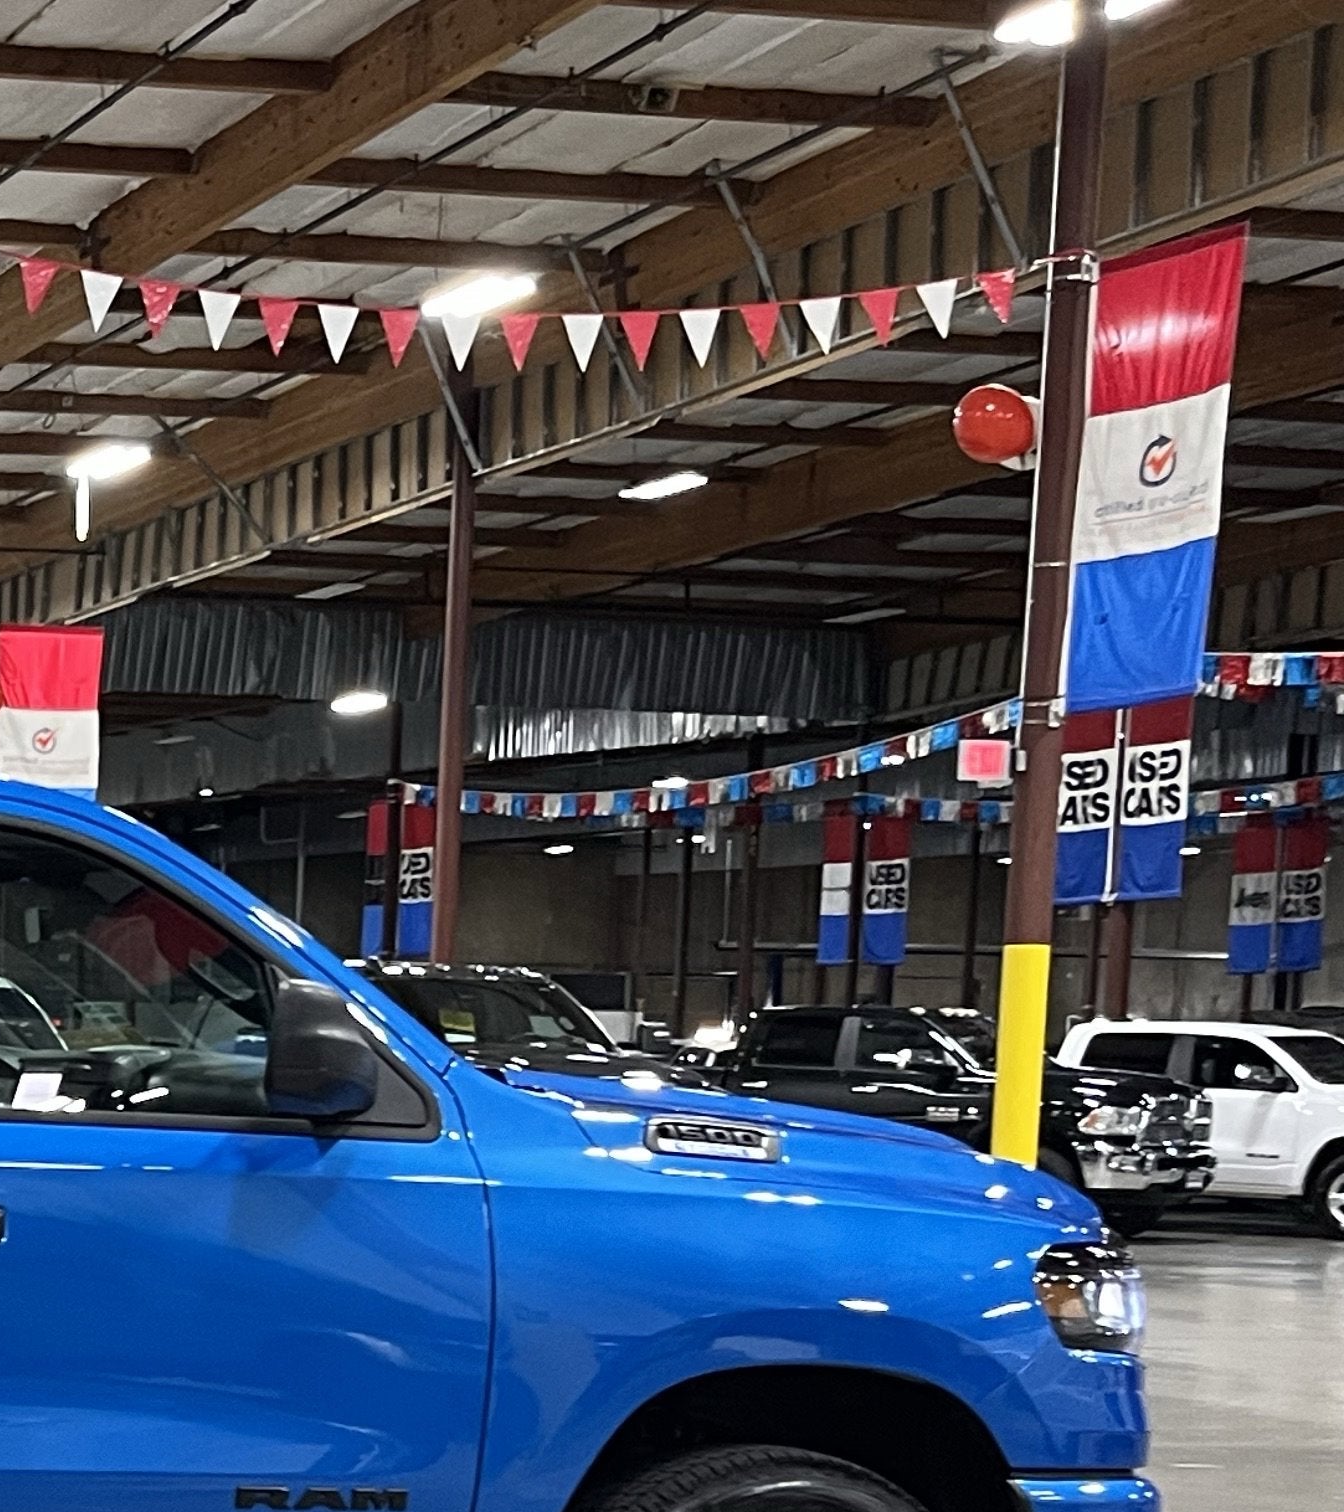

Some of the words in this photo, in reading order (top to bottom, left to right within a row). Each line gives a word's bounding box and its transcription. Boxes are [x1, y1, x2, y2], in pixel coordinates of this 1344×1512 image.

[1064, 758, 1109, 791] SED
[661, 1123, 762, 1147] 1500
[235, 1486, 409, 1512] RAM
